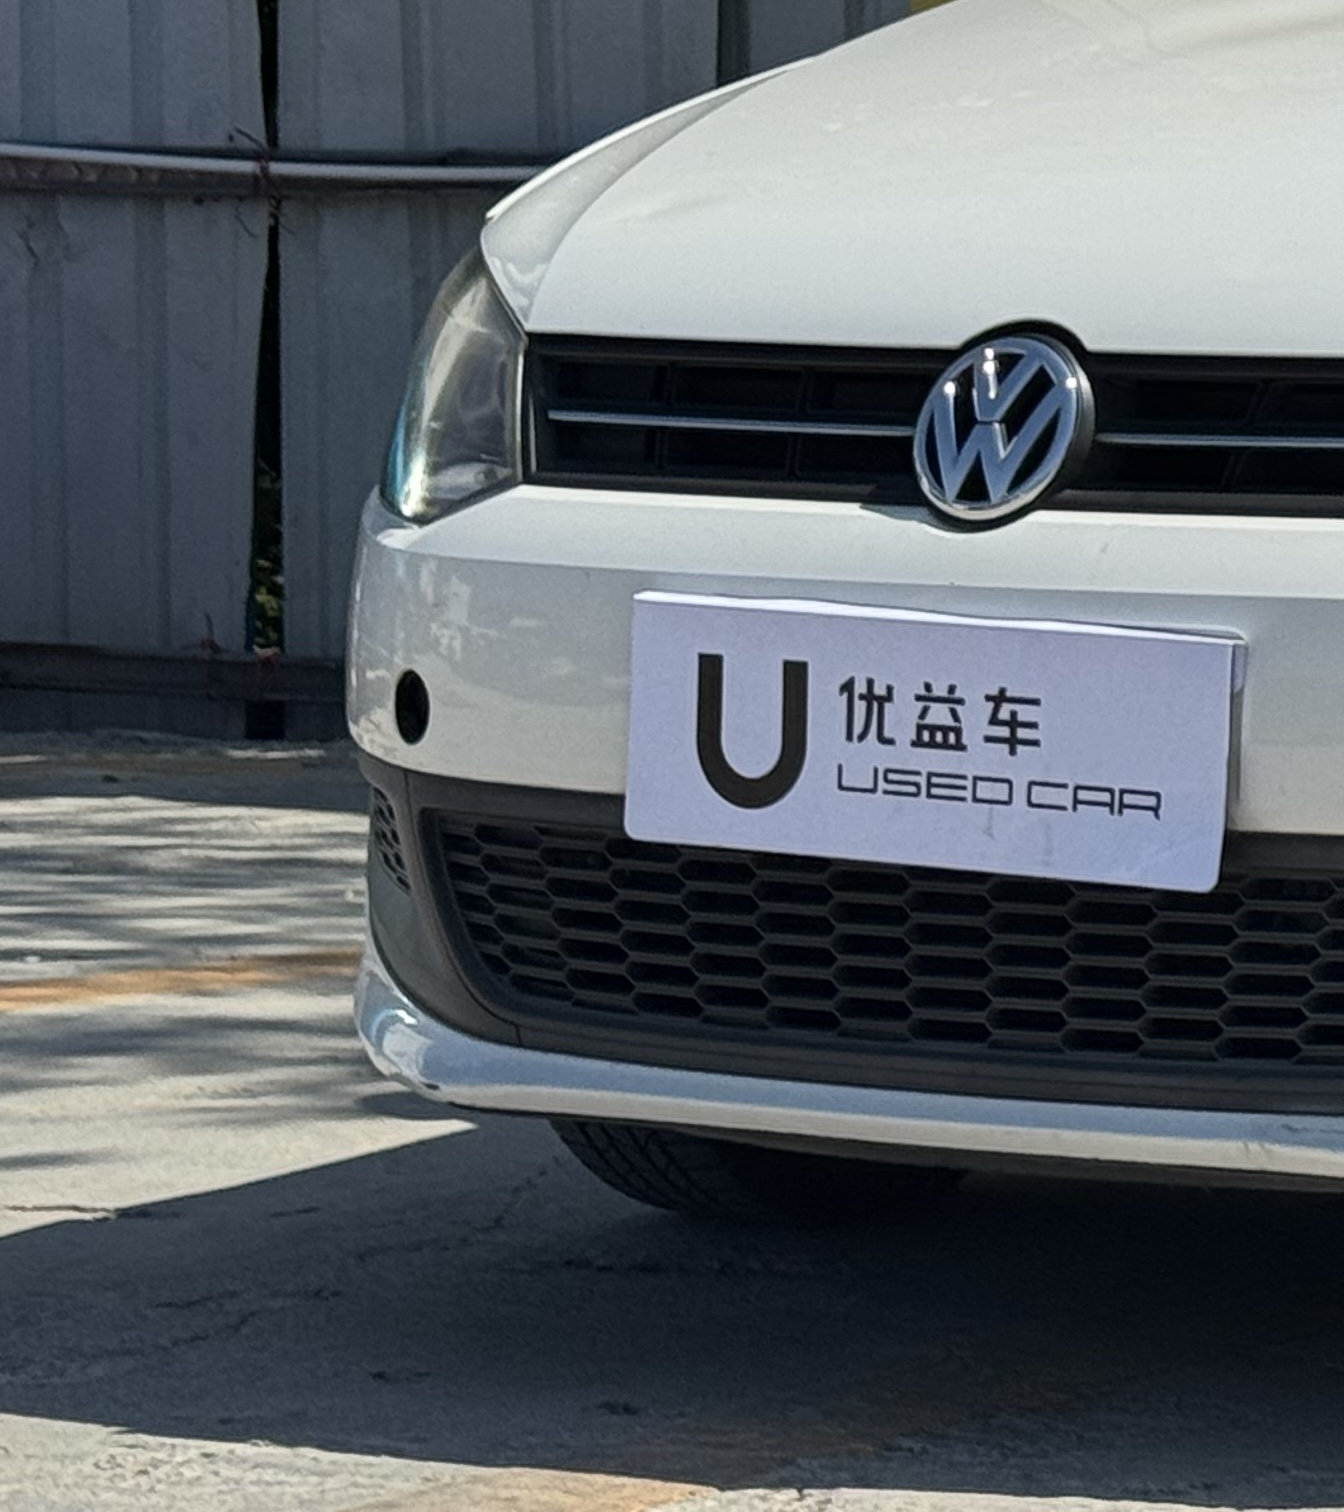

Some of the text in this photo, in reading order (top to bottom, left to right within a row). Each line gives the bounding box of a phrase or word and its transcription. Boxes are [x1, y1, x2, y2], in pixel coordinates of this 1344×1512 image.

[916, 336, 1077, 510] VW
[696, 653, 808, 809] U
[839, 677, 1041, 756] 优益车
[837, 764, 1161, 820] USED CAR
